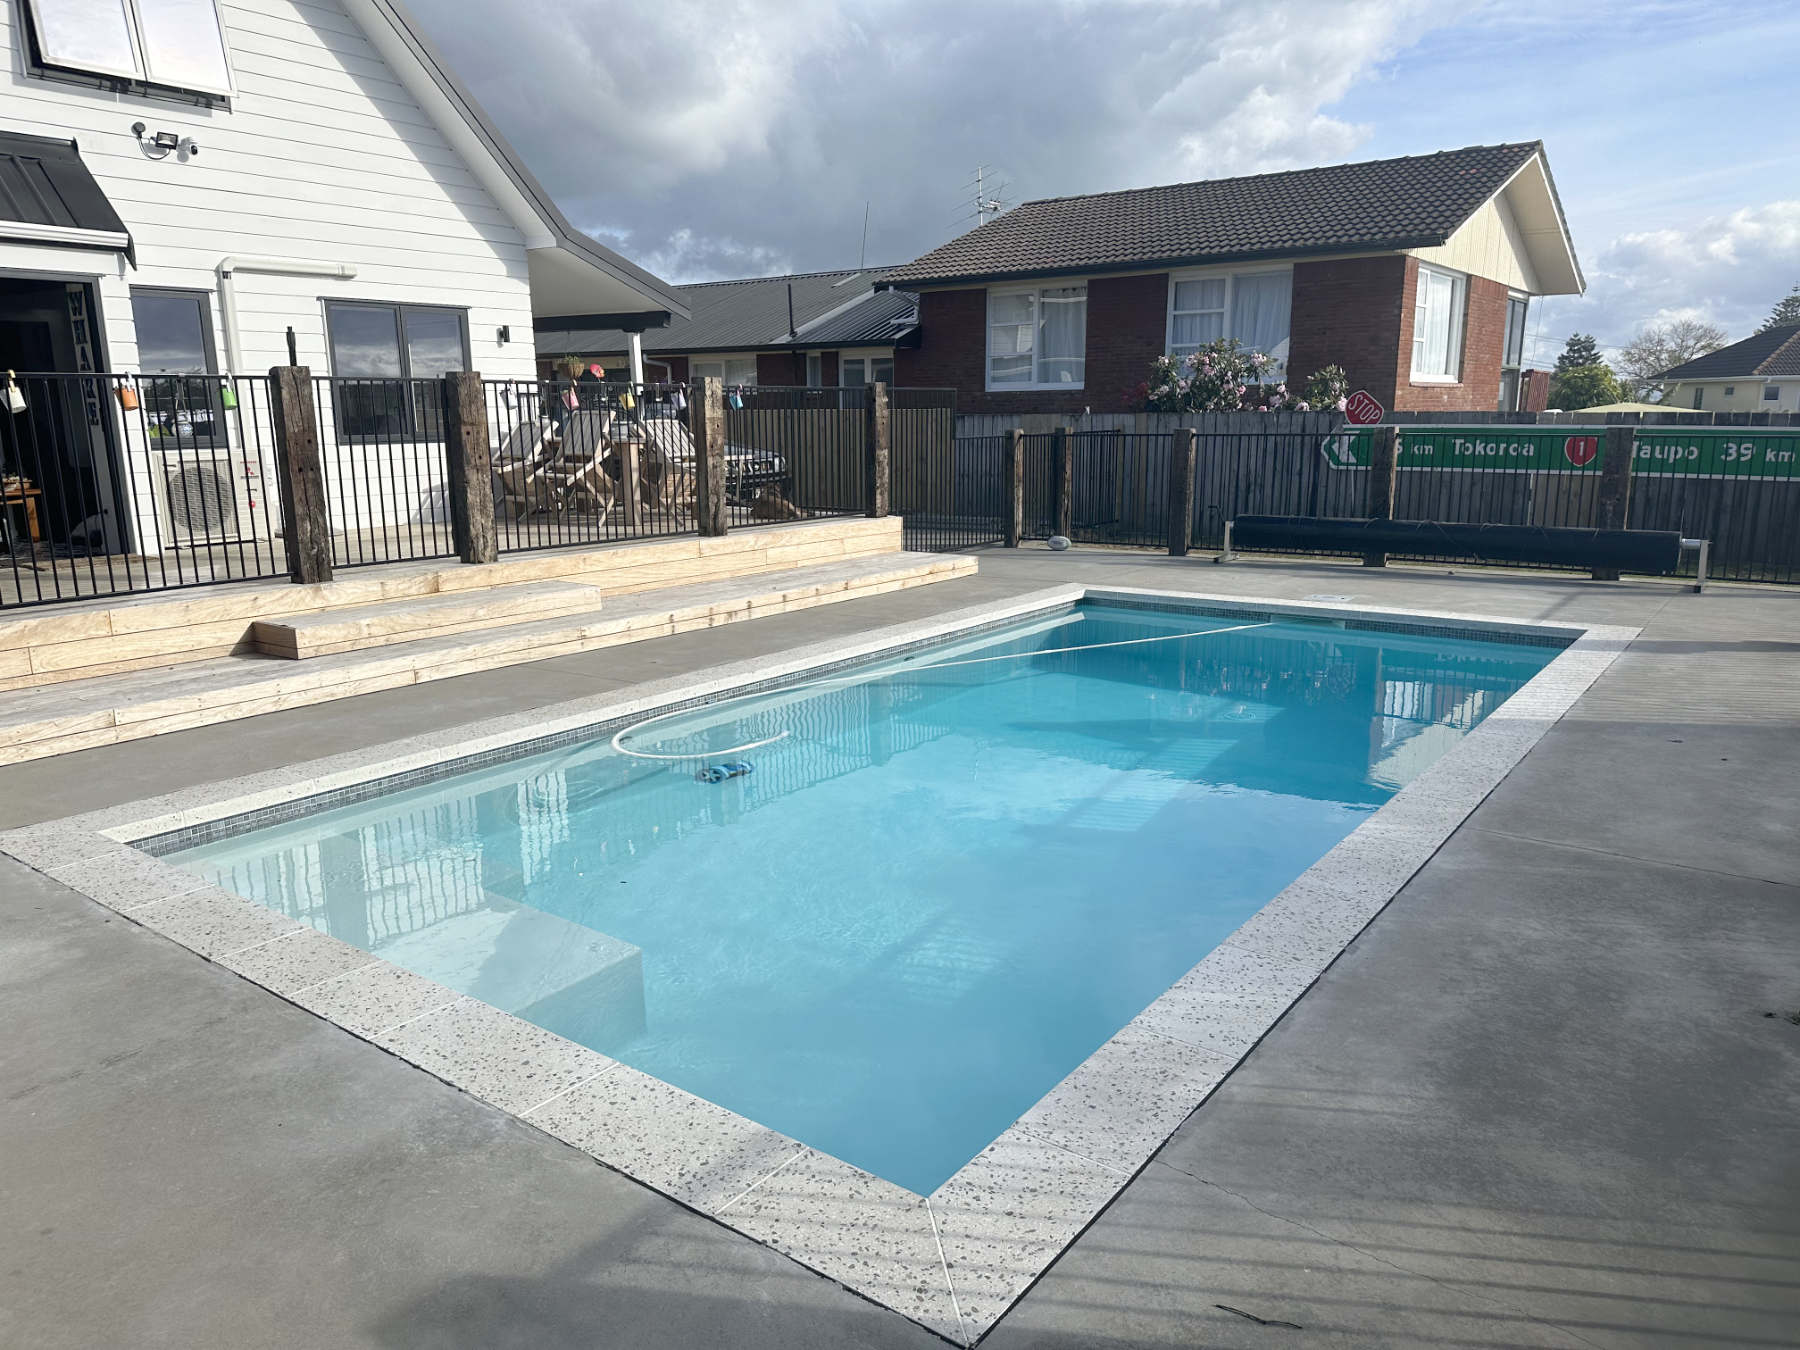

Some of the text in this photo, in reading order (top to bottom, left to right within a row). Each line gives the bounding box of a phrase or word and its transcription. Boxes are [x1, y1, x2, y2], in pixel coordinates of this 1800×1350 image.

[1348, 394, 1380, 424] STOP
[1452, 439, 1535, 456] Tokoroa
[1721, 442, 1756, 462] 39
[1765, 447, 1796, 463] km
